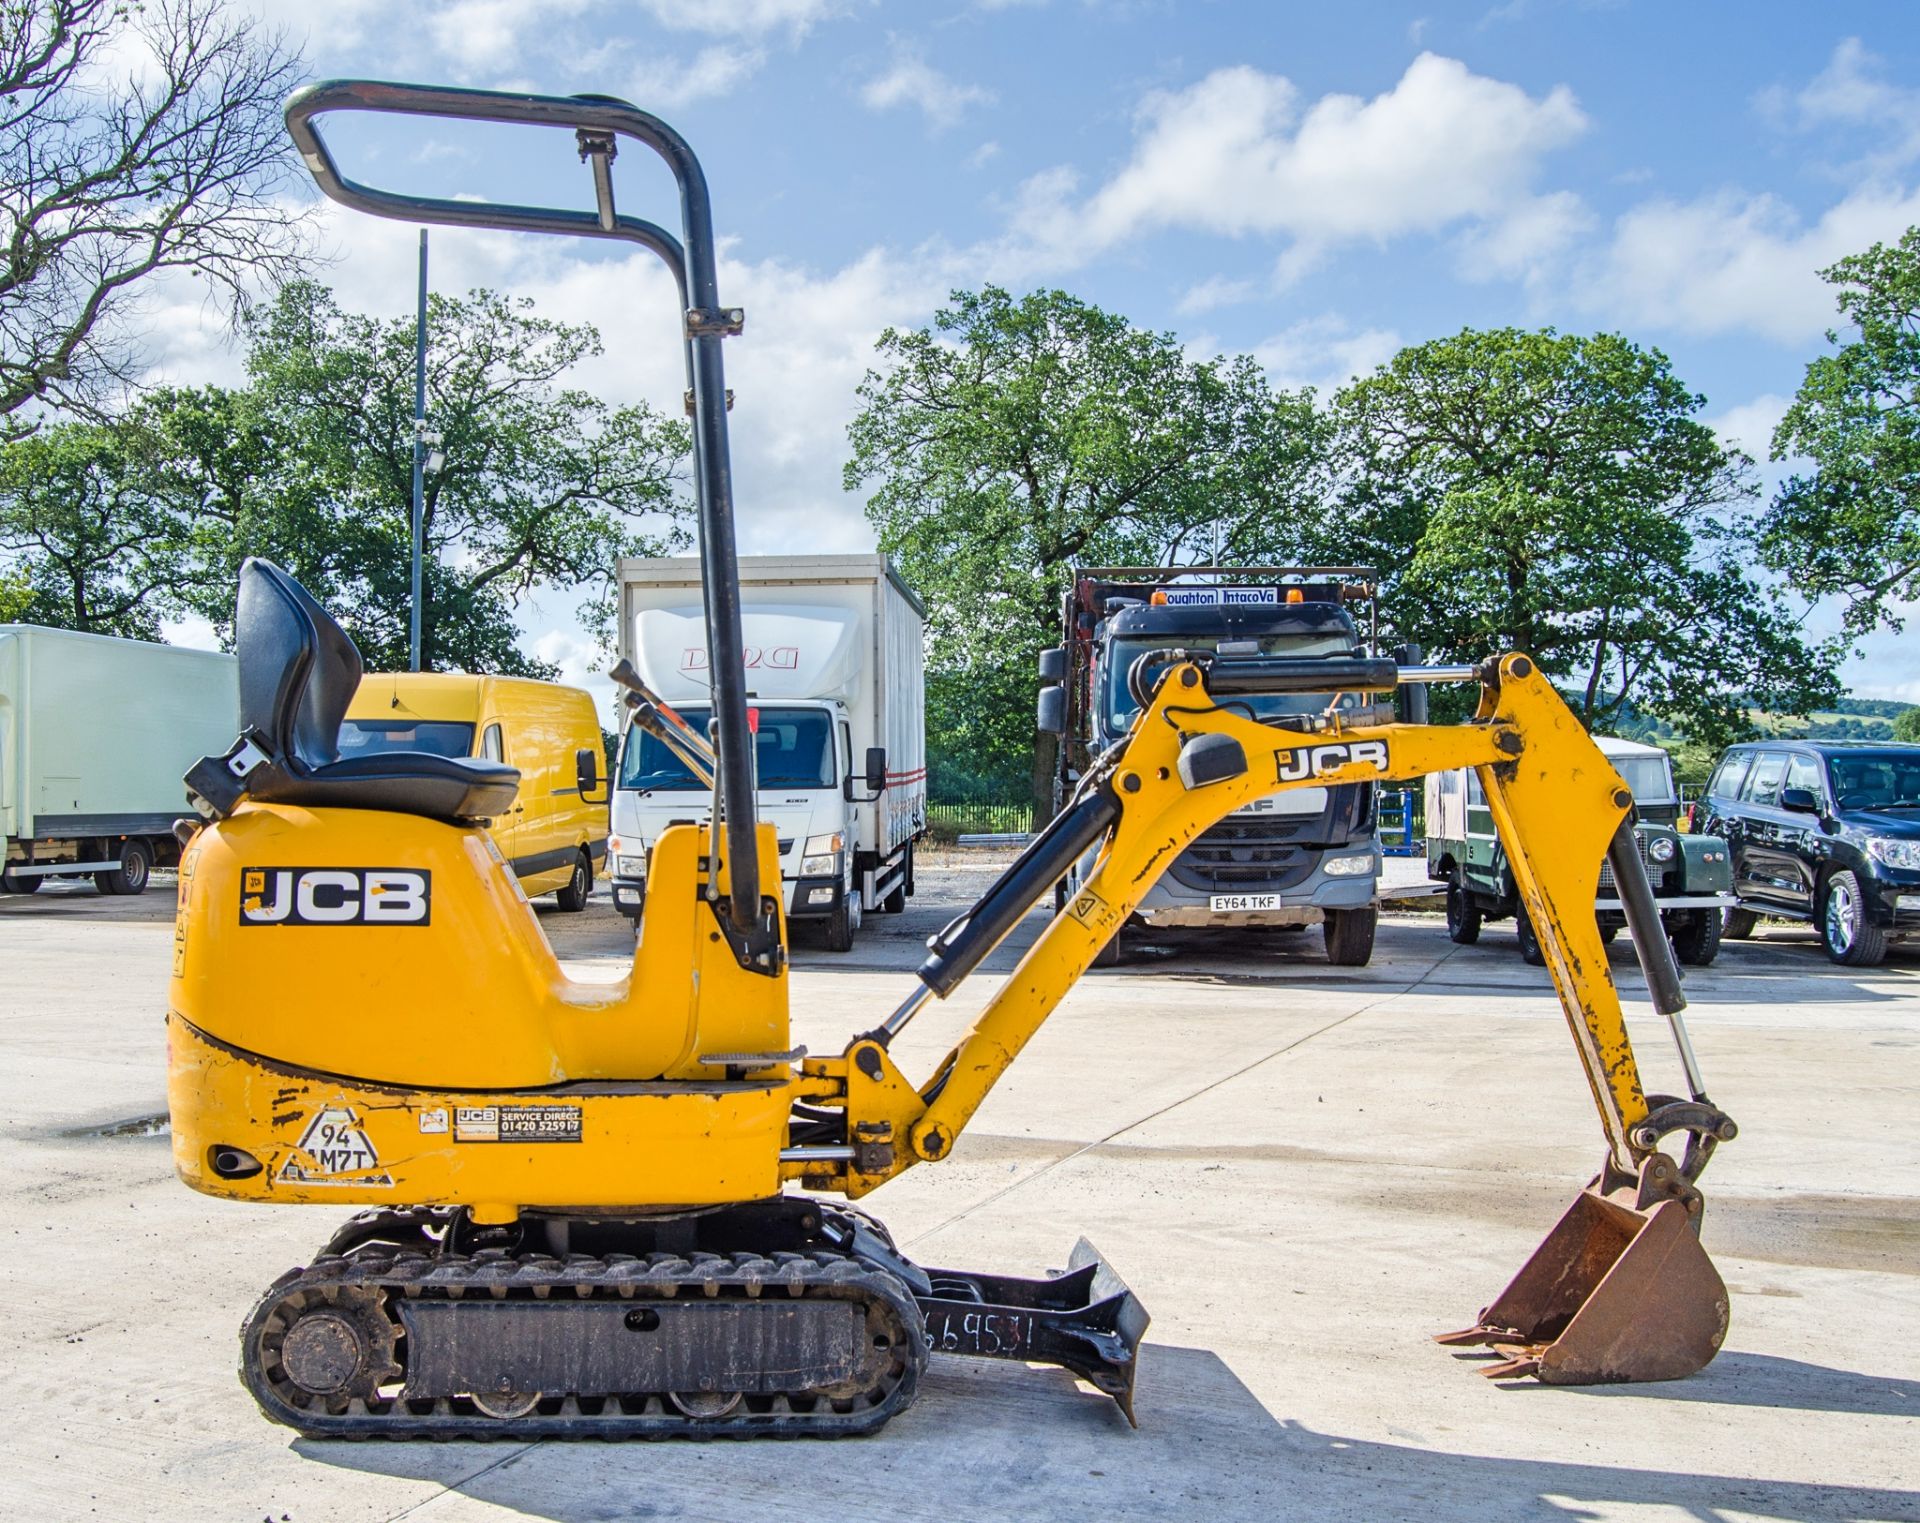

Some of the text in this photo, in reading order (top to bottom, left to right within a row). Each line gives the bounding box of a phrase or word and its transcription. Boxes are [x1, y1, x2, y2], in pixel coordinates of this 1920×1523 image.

[1163, 592, 1214, 604] oughton
[1279, 742, 1387, 781] JCB
[1234, 799, 1274, 812] AF
[244, 871, 426, 921] JCB
[1215, 896, 1275, 909] EY64 TKF
[460, 1110, 496, 1121] JCB
[501, 1112, 580, 1121] SERVICE DIRECT
[501, 1121, 580, 1132] 01420 525917
[321, 1124, 351, 1147] 94
